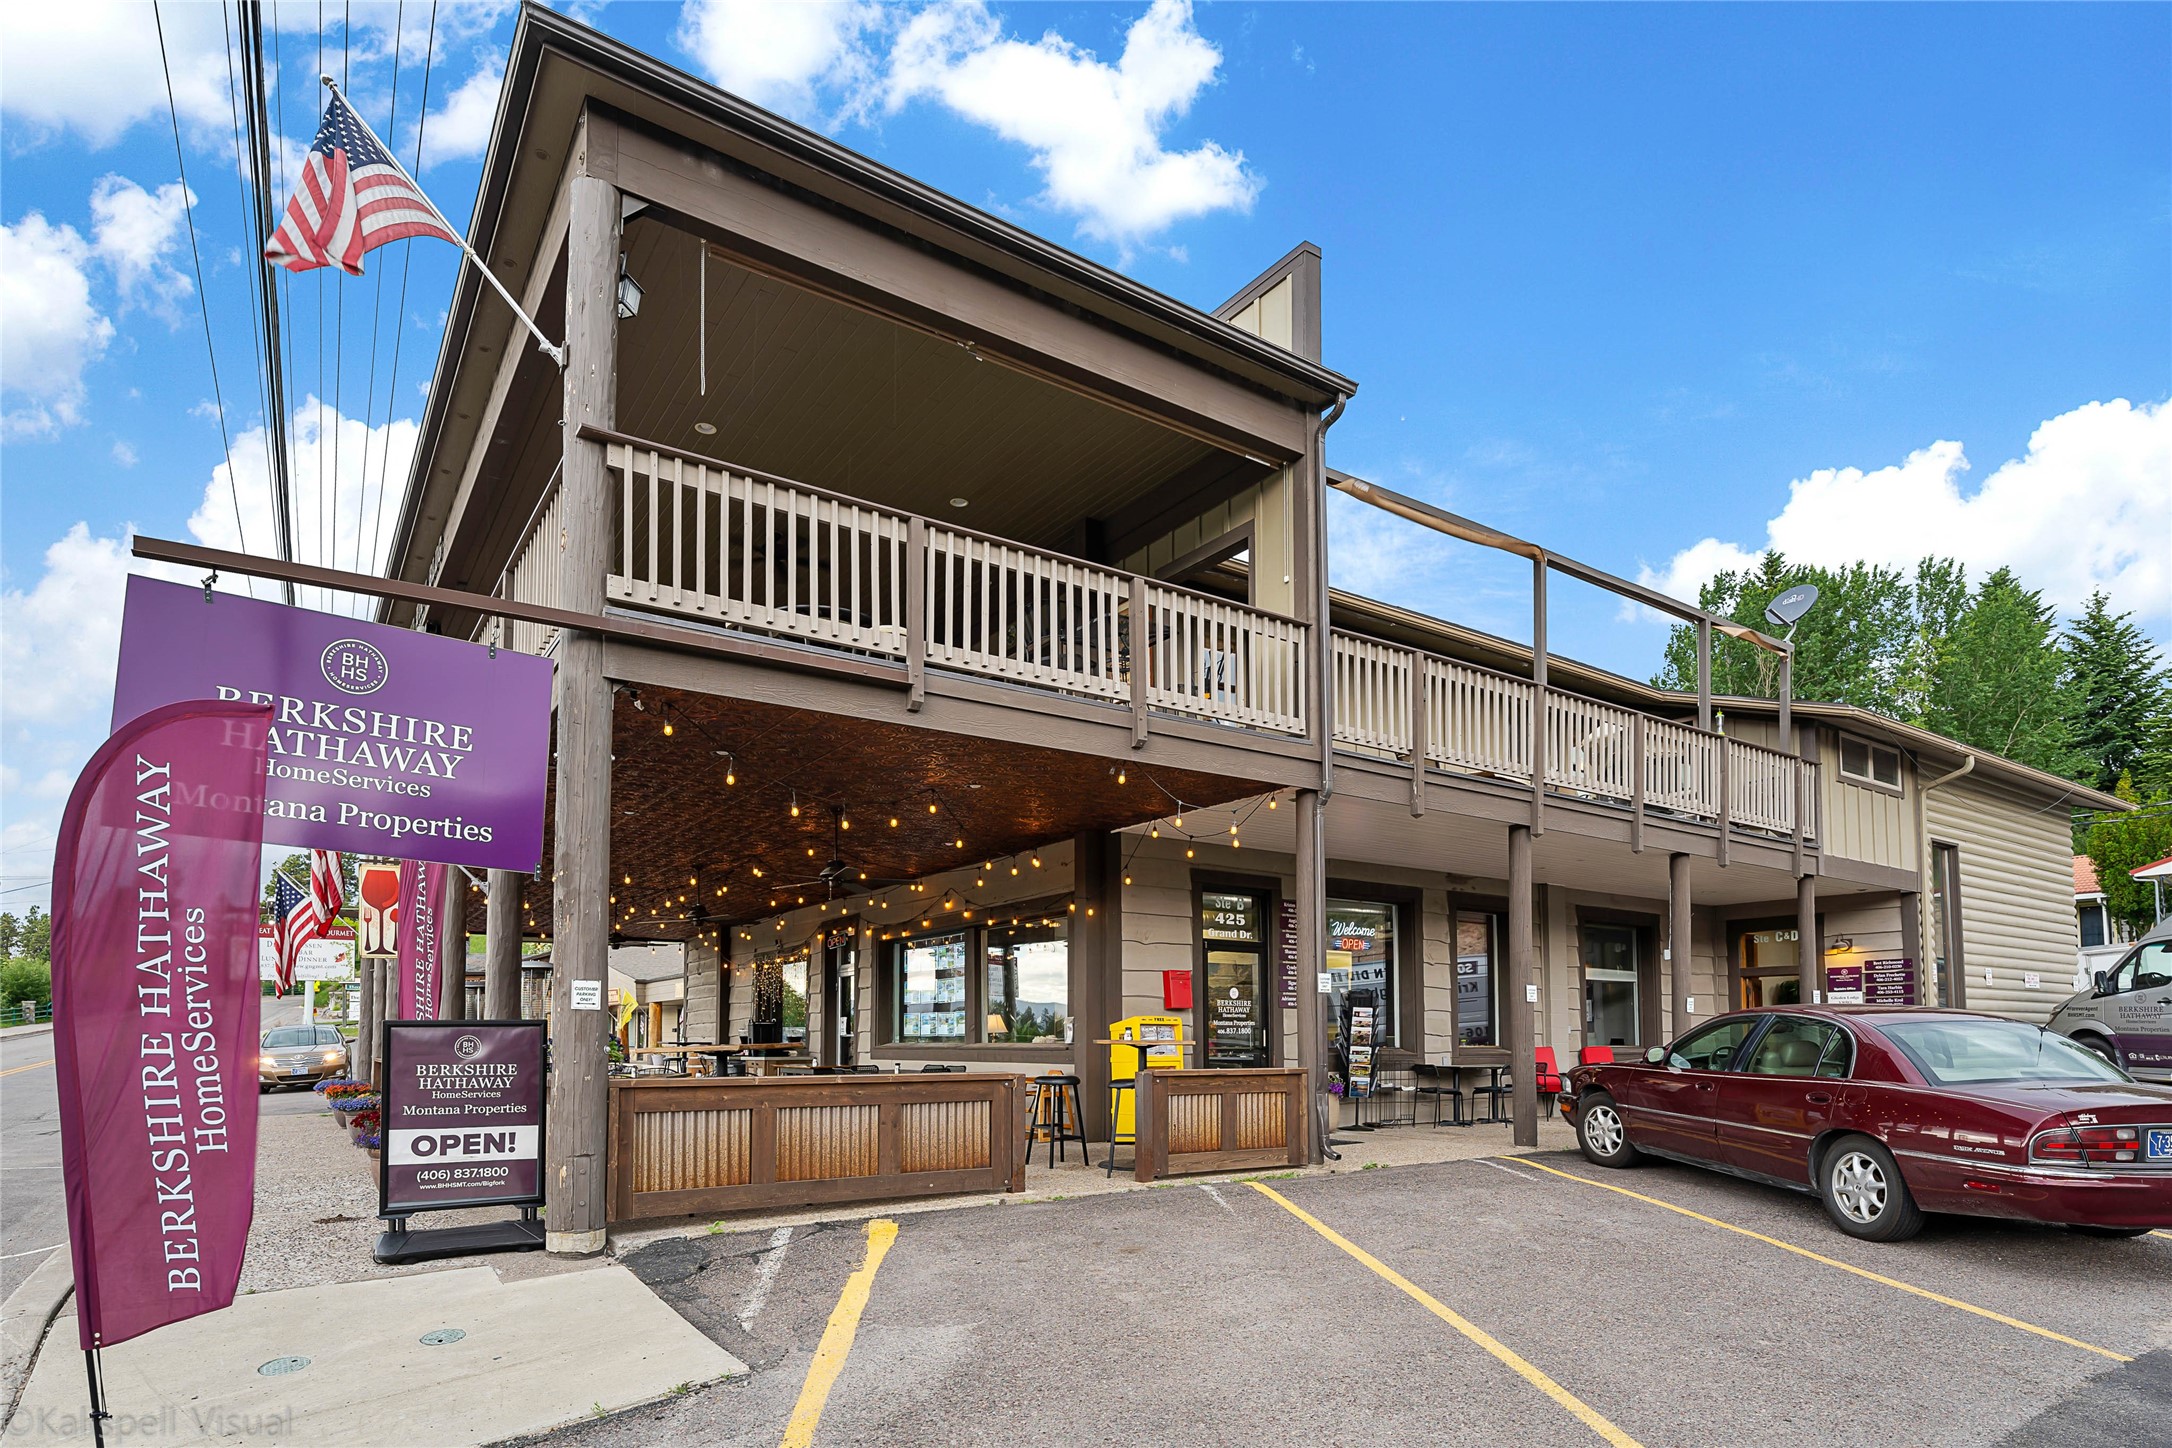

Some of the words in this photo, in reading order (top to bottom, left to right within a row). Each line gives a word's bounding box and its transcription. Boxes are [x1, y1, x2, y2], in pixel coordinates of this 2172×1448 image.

[342, 652, 369, 669] BH
[341, 665, 367, 682] HS
[220, 719, 464, 780] HATHAWAY
[254, 756, 432, 799] HomeServices
[174, 781, 328, 823] Montana
[337, 801, 494, 843] Properties
[135, 753, 171, 1018] HATHAWAY
[1214, 912, 1246, 926] 425
[1207, 928, 1238, 938] Grand
[1239, 930, 1254, 939] Dr.
[1331, 920, 1376, 937] Welcome
[1341, 938, 1364, 950] OPEN
[1753, 934, 1770, 944] Ste
[1775, 930, 1799, 942] C&D
[177, 906, 230, 1154] HomeServices
[2140, 1025, 2171, 1034] Properties
[415, 1064, 518, 1077] BERKSHIRE
[418, 1076, 515, 1090] HATHAWAY
[431, 1090, 502, 1099] HomeServices
[402, 1105, 461, 1116] Montana
[464, 1103, 528, 1116] Properties
[410, 1131, 517, 1157] OPEN!
[139, 1032, 202, 1294] BERKSHIRE
[416, 1169, 451, 1183] (406)
